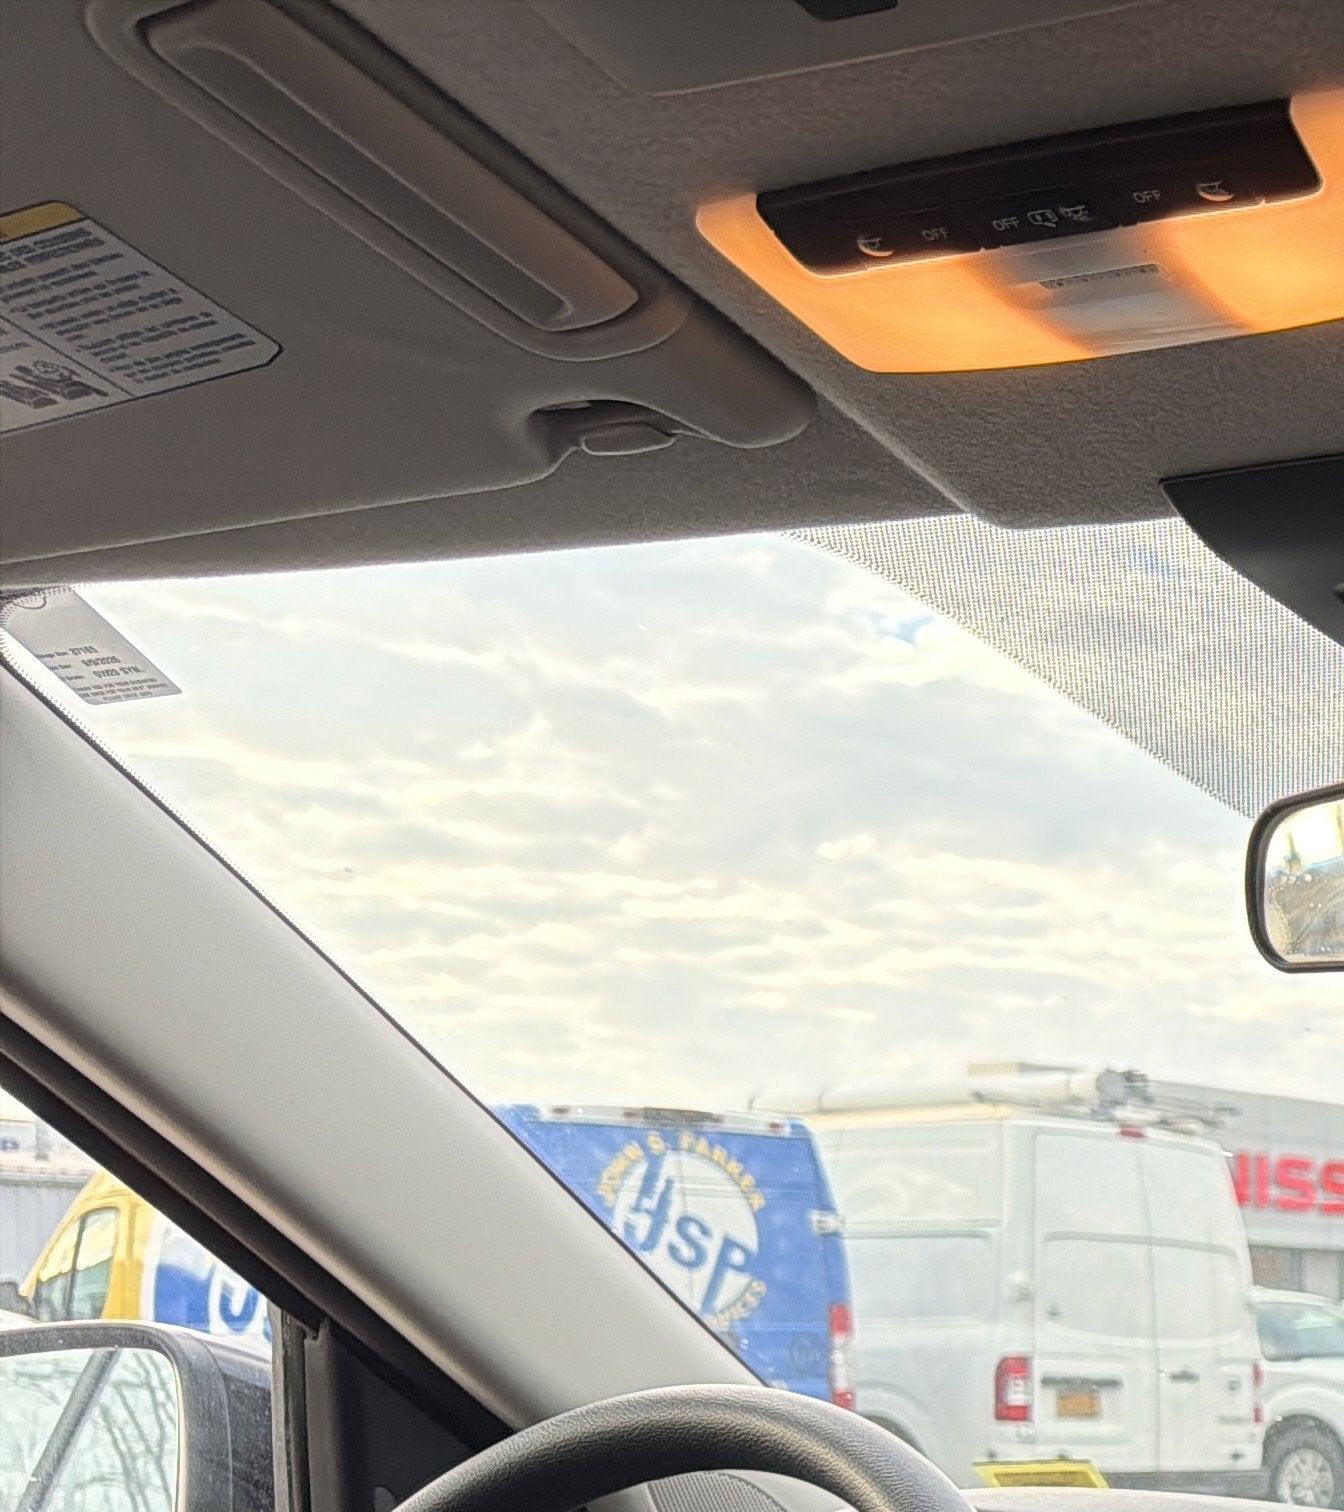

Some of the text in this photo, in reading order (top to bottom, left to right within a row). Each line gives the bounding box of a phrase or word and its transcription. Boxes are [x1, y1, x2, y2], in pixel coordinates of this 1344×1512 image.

[1132, 189, 1161, 204] OFF
[992, 216, 1020, 232] OFF
[921, 226, 949, 242] OFF
